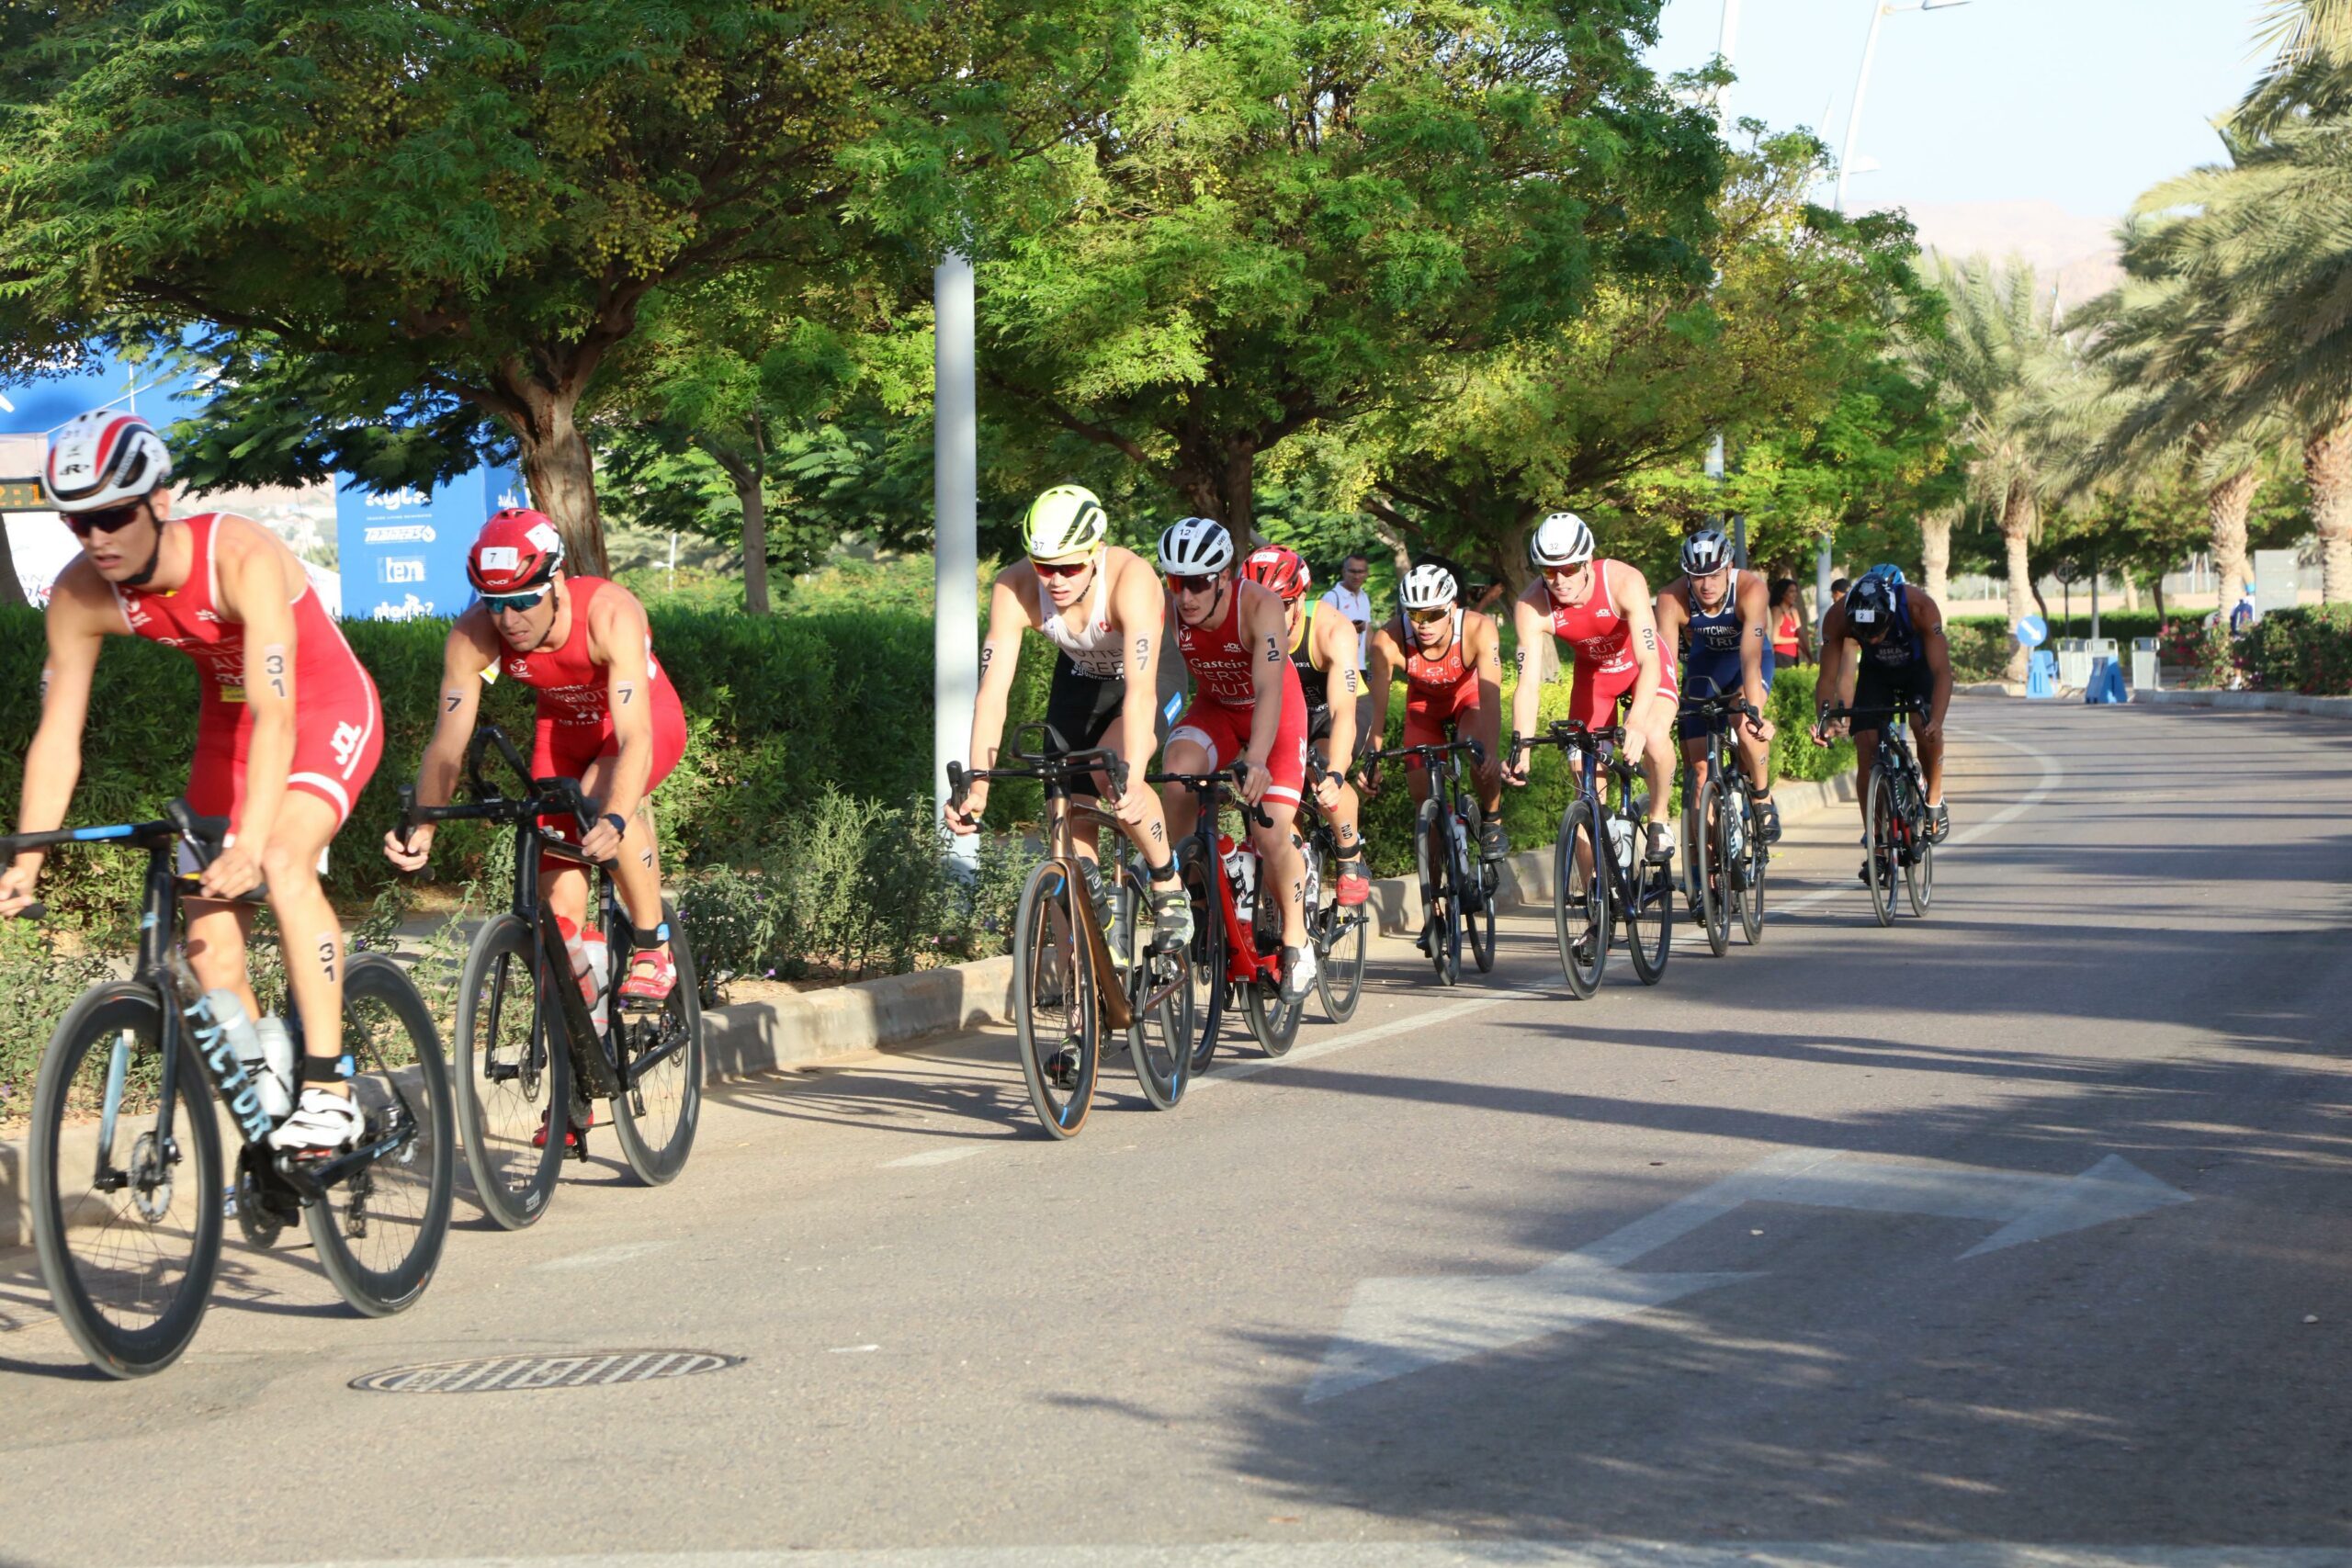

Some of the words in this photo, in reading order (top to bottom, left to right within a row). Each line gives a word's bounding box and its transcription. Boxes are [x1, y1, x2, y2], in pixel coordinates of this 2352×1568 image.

[1179, 528, 1192, 536] 12
[1033, 540, 1046, 552] 37
[1549, 542, 1559, 550] 32
[490, 552, 497, 564] 7
[1642, 627, 1656, 650] 32
[1755, 627, 1763, 637] 3
[1136, 637, 1149, 671] 37
[1267, 637, 1281, 662] 12
[1189, 658, 1248, 670] Gastein
[266, 654, 286, 697] 31
[1344, 669, 1356, 693] 25
[616, 688, 633, 705] 7
[1211, 682, 1250, 696] AUT
[447, 696, 462, 713] 7
[642, 853, 653, 868] 7
[318, 942, 337, 983] 31
[184, 995, 273, 1144] FACTOR
